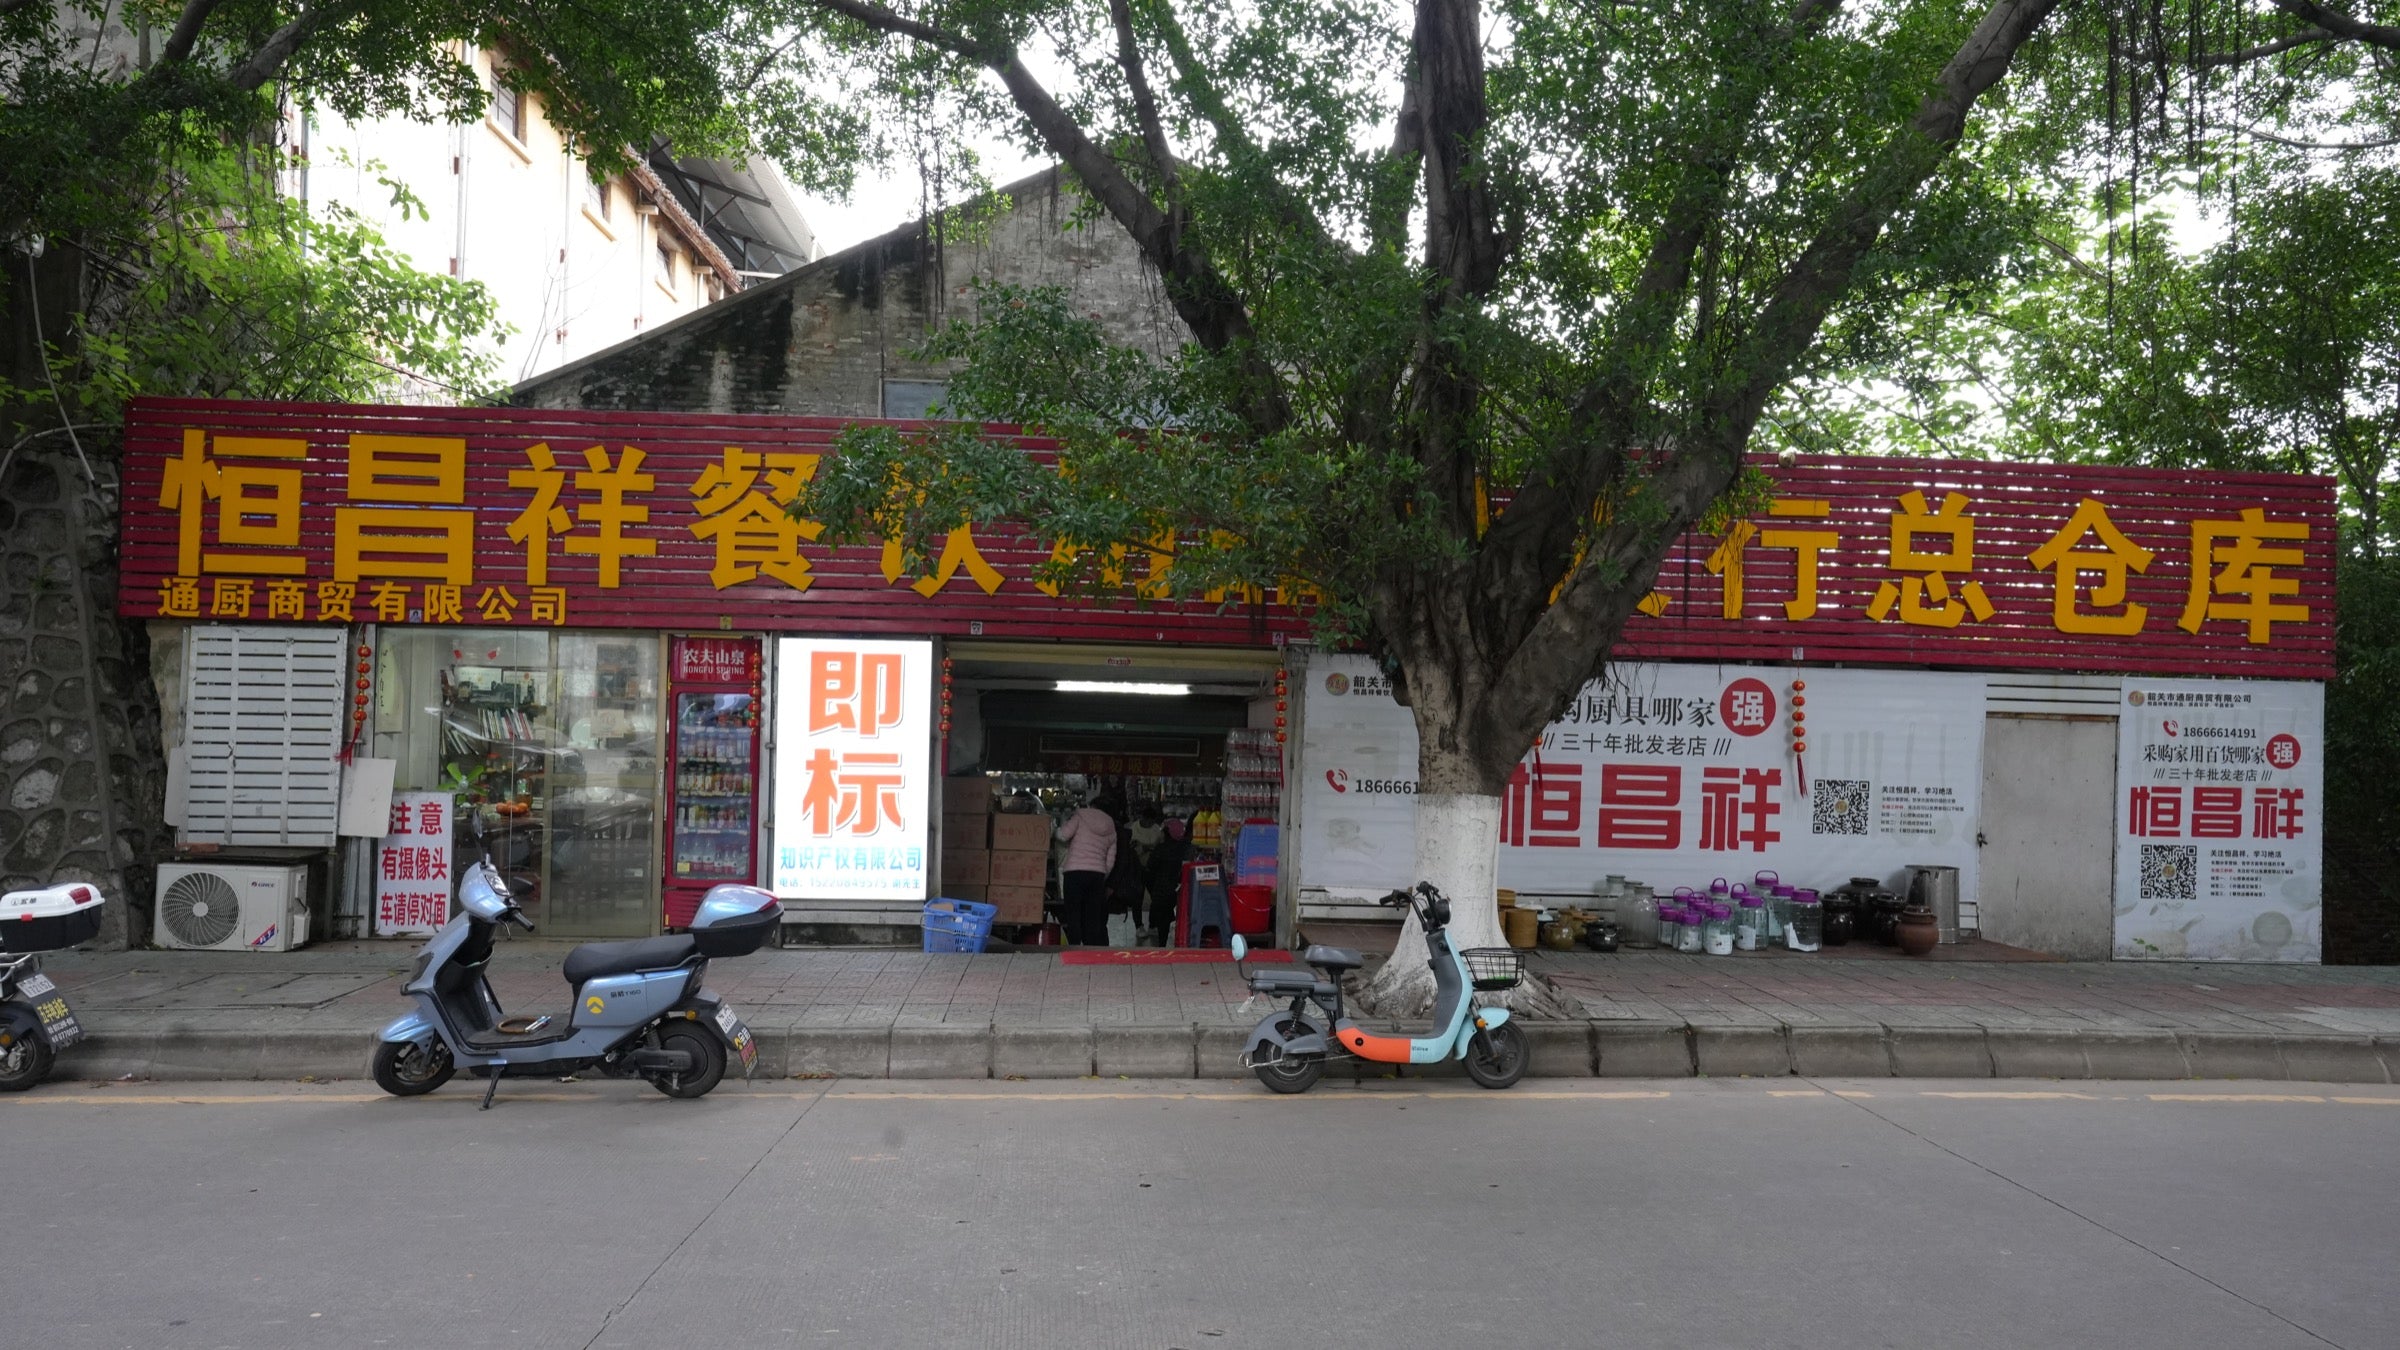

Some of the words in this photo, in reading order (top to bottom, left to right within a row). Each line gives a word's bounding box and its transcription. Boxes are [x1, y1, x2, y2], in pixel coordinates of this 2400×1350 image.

[157, 577, 567, 626] 通厨商贸有限公司
[684, 648, 745, 665] 农夫山泉
[683, 665, 713, 674] NONGFU
[716, 666, 745, 675] SPRING
[1353, 674, 1392, 689] 韶关市
[1732, 690, 1766, 728] 强
[2147, 692, 2251, 703] 韶关市通厨商贸有限公司
[803, 650, 903, 836] 即标
[1561, 733, 1707, 757] 三十年批发老店
[2183, 727, 2257, 739] 18666614191
[2143, 744, 2266, 764] 采购家用百货哪家
[2273, 741, 2295, 764] 强
[2168, 768, 2257, 782] 三十年批发老店
[388, 802, 443, 835] 注意
[1500, 763, 1782, 852] 恒昌祥
[2129, 786, 2304, 839] 恒昌祥
[382, 846, 447, 880] 有摄像头
[780, 847, 921, 871] 知识产权有限公司
[380, 892, 447, 926] 车请停对面
